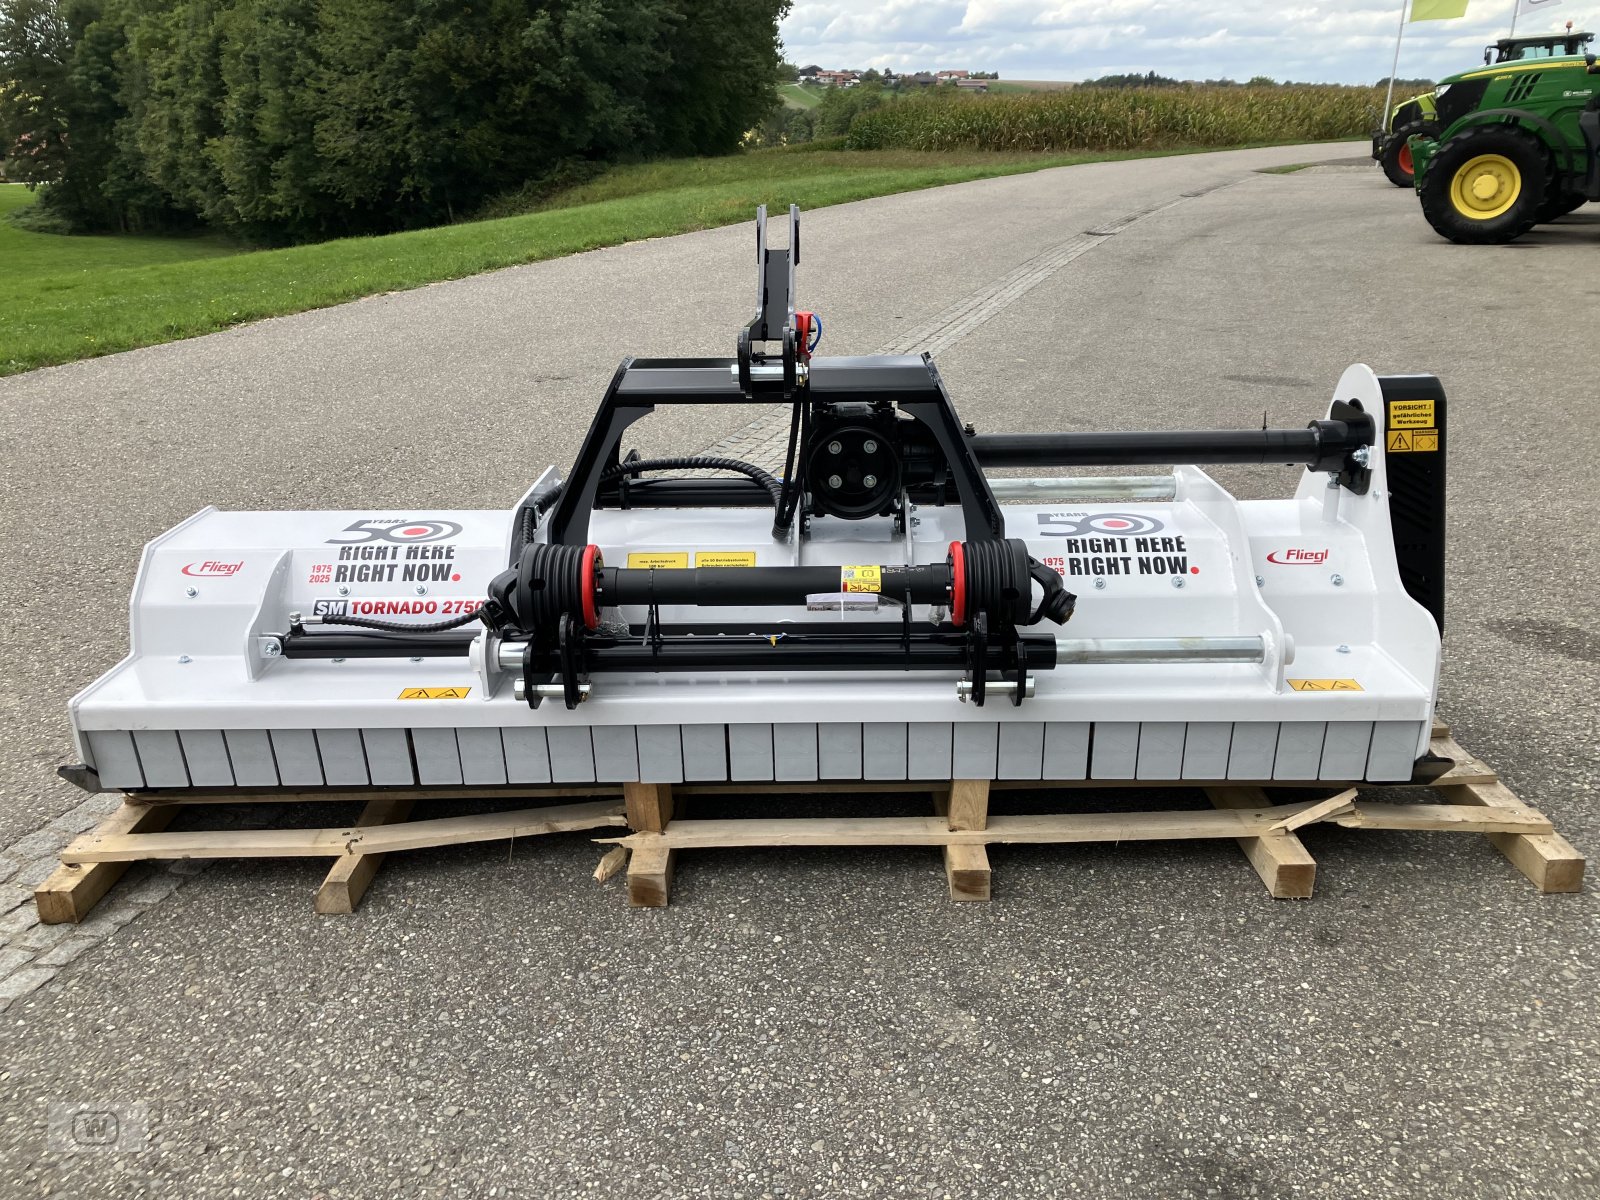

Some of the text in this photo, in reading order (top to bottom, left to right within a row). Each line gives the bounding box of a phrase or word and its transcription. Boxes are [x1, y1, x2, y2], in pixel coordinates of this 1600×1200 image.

[1066, 536, 1187, 553] RIGHT HERE
[338, 545, 456, 561] RIGHT HERE
[1285, 549, 1329, 563] Fliegl
[199, 561, 244, 575] Fliegl
[1042, 557, 1064, 566] 1975
[1068, 557, 1132, 576] RIGHT
[311, 565, 332, 573] 1975
[334, 564, 398, 582] RIGHT
[308, 575, 330, 583] 2025
[315, 601, 344, 615] SM
[352, 601, 438, 615] TORNADO
